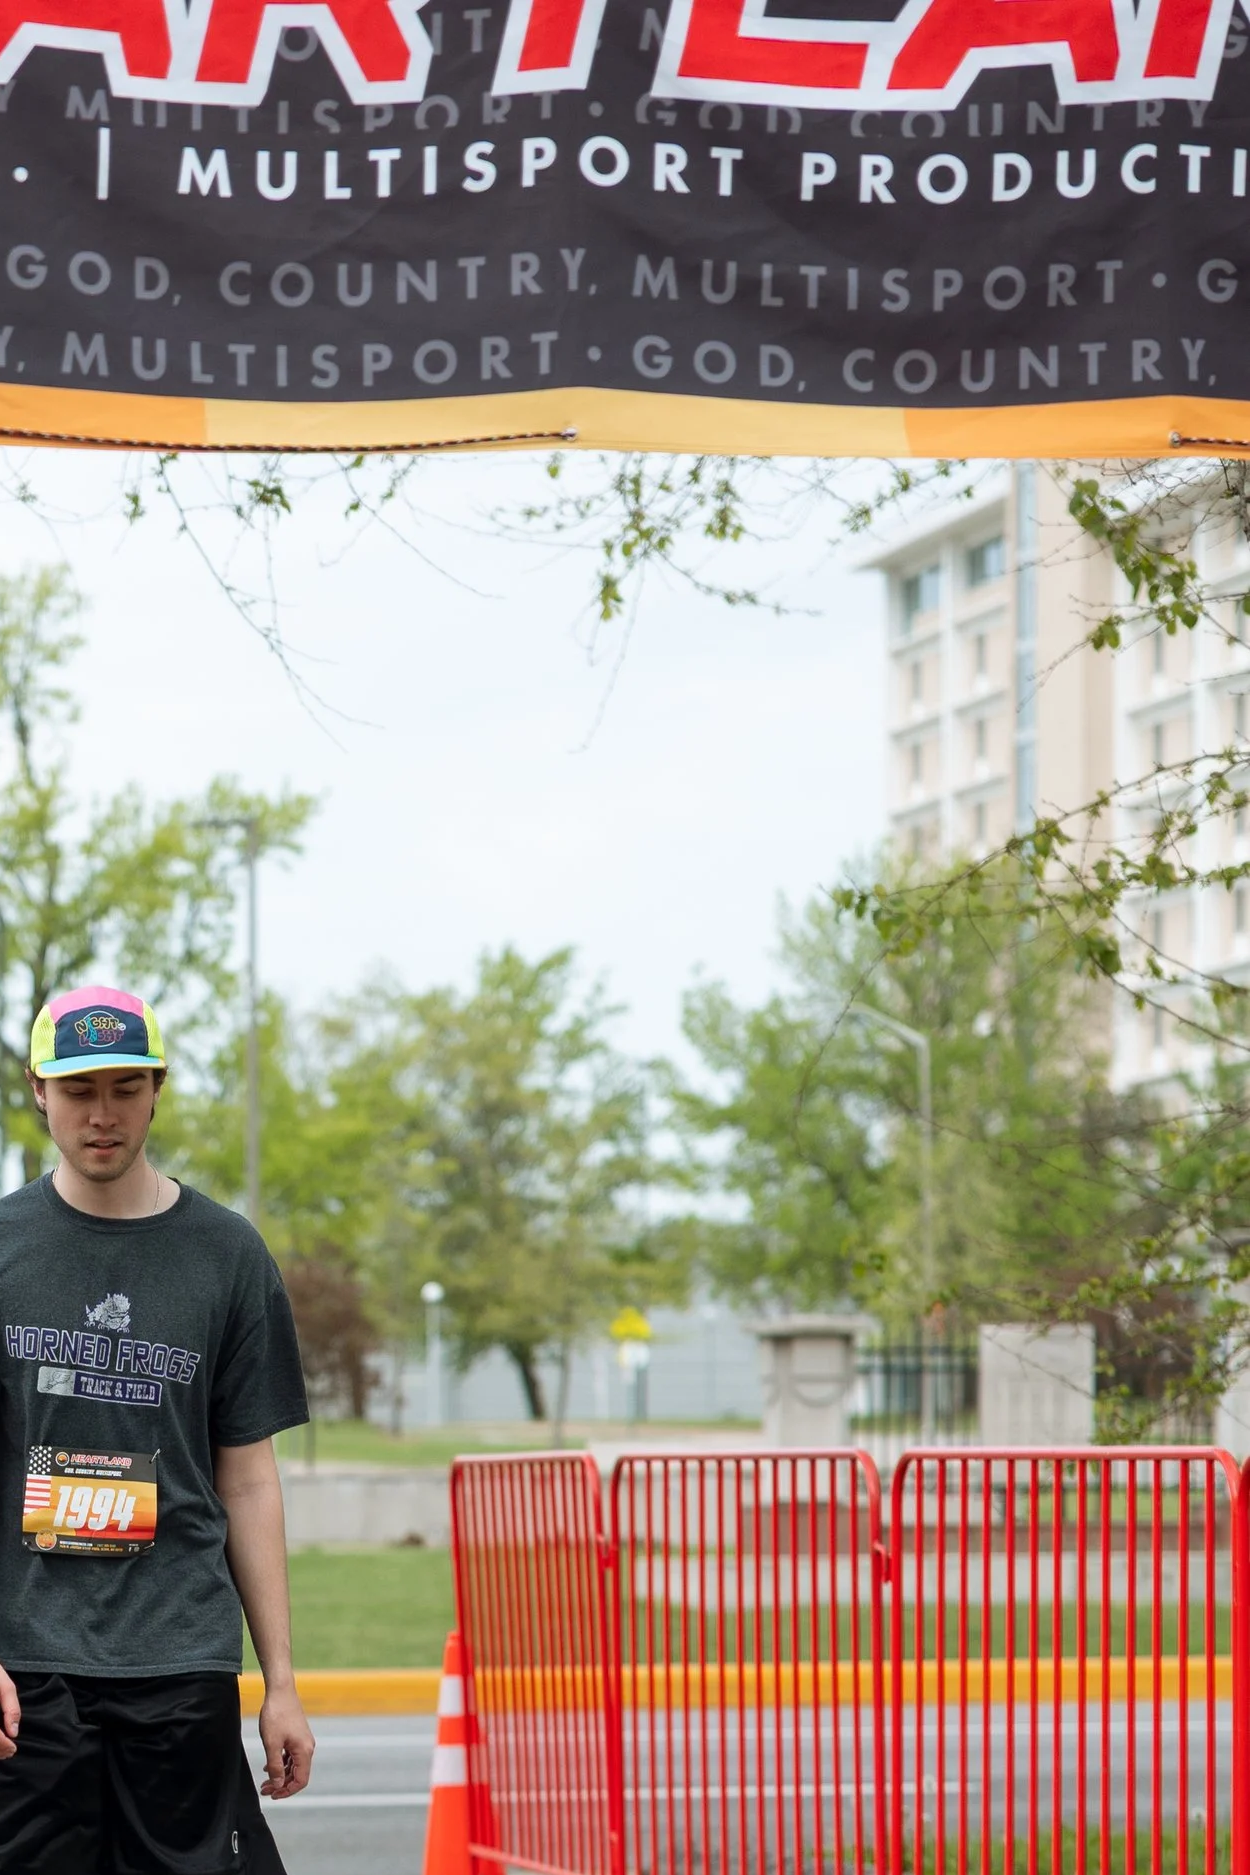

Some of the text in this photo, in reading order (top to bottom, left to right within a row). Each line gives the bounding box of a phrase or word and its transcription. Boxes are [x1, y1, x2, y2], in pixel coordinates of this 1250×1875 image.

[177, 136, 743, 200] MULTISPORT
[801, 144, 1247, 204] PRODUCTI
[6, 244, 181, 305] GOD,
[219, 248, 597, 308] COUNTRY,
[632, 256, 1124, 313] MULTISPORT
[60, 331, 558, 389] MULTISPORT
[631, 335, 806, 393] GOD,
[842, 338, 1217, 394] COUNTRY,
[5, 1325, 201, 1385] HORNED FROGS
[80, 1376, 156, 1401] TRACK & FIELD
[53, 1485, 136, 1531] 1994
